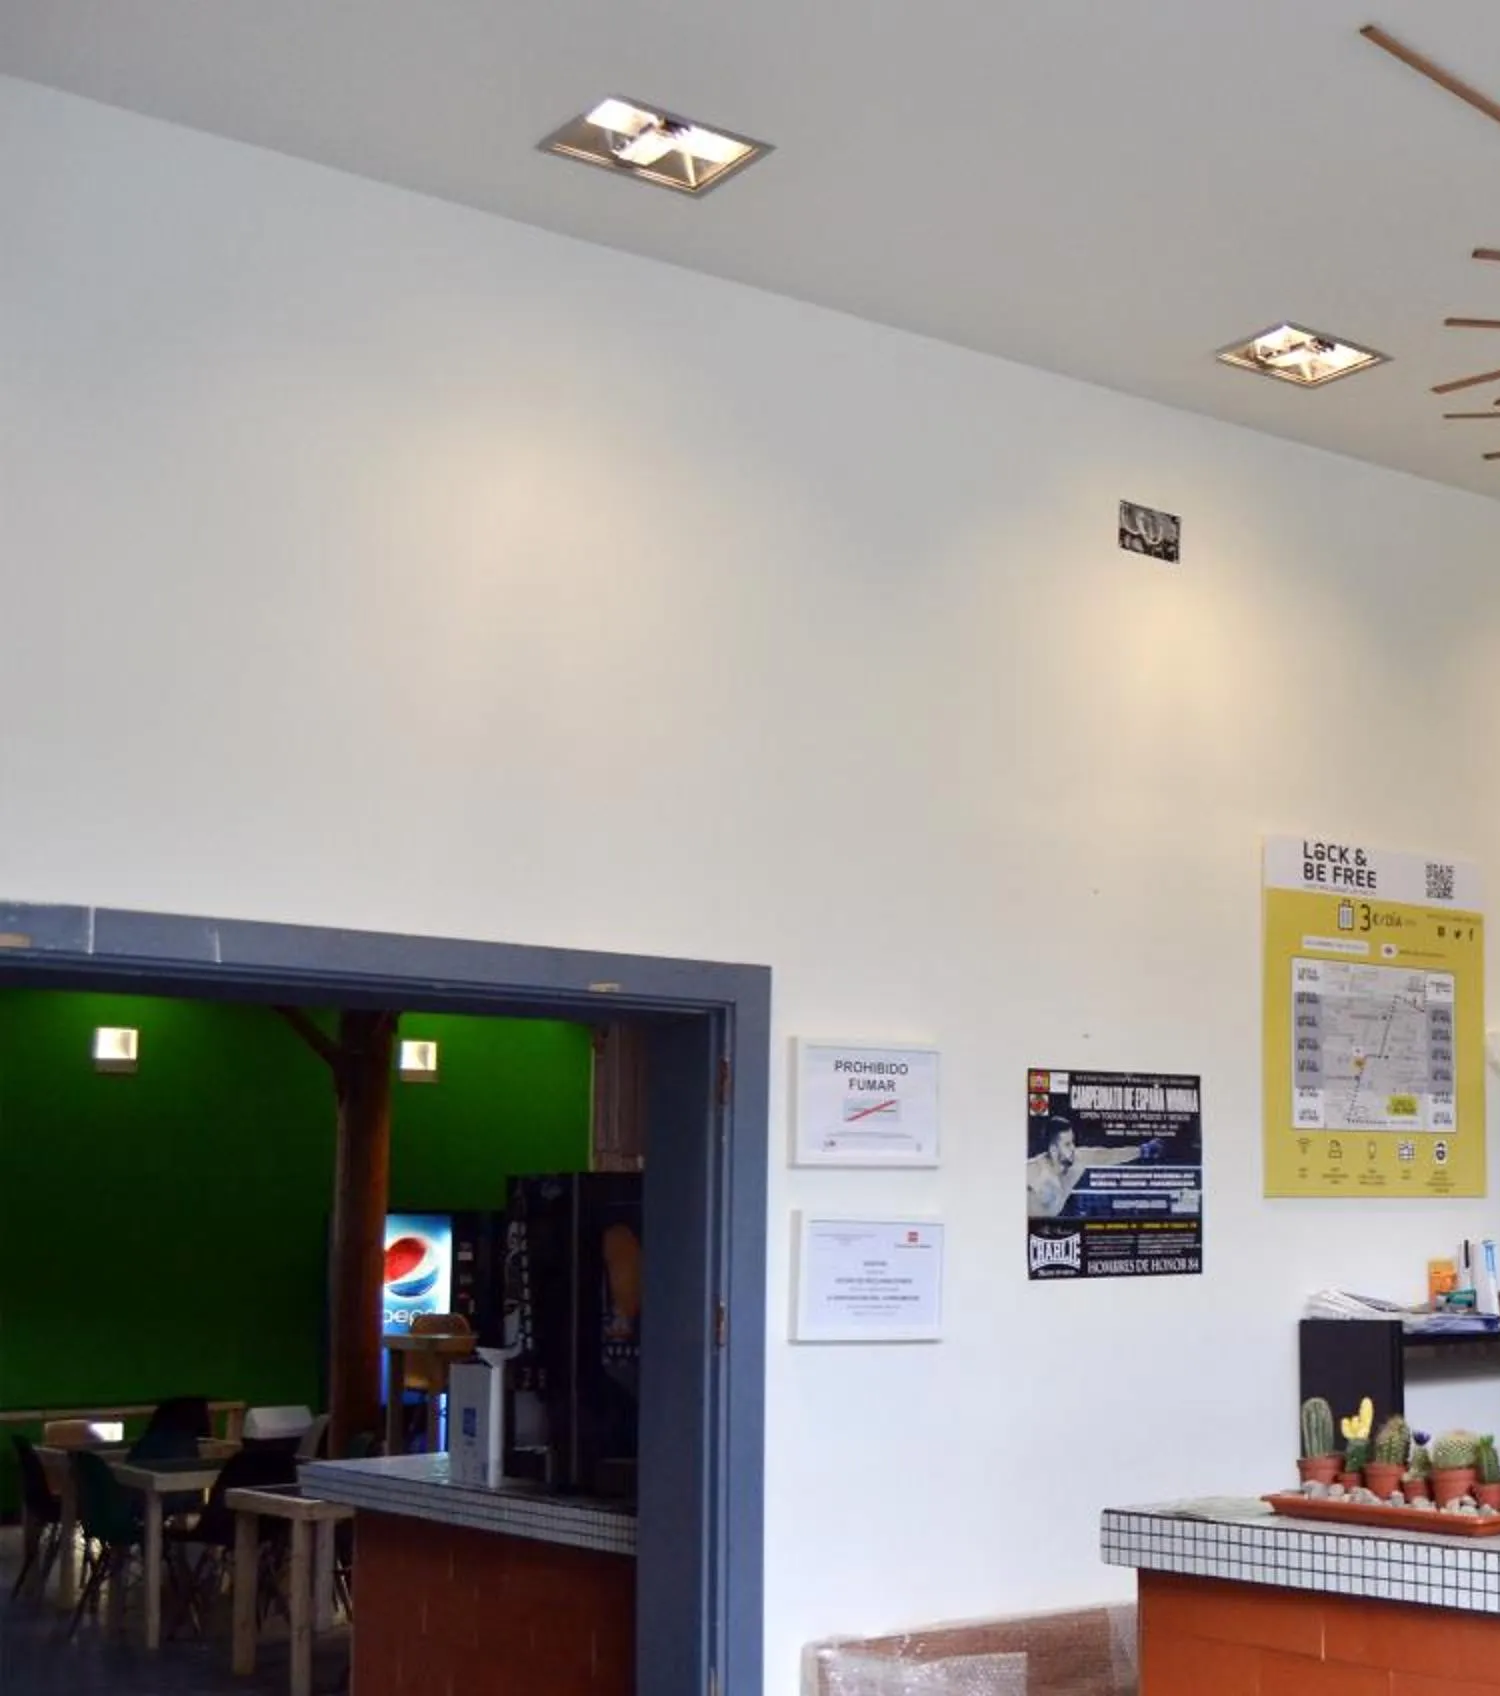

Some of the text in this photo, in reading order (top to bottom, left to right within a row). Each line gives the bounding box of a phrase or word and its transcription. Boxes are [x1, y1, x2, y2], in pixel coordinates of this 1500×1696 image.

[1303, 841, 1368, 867] LOCK &
[1303, 862, 1327, 882] BE
[1332, 866, 1377, 889] FREE
[834, 1059, 909, 1076] PROHIBIDO
[848, 1077, 896, 1093] FUMAR
[1030, 1233, 1081, 1271] CHARLIE
